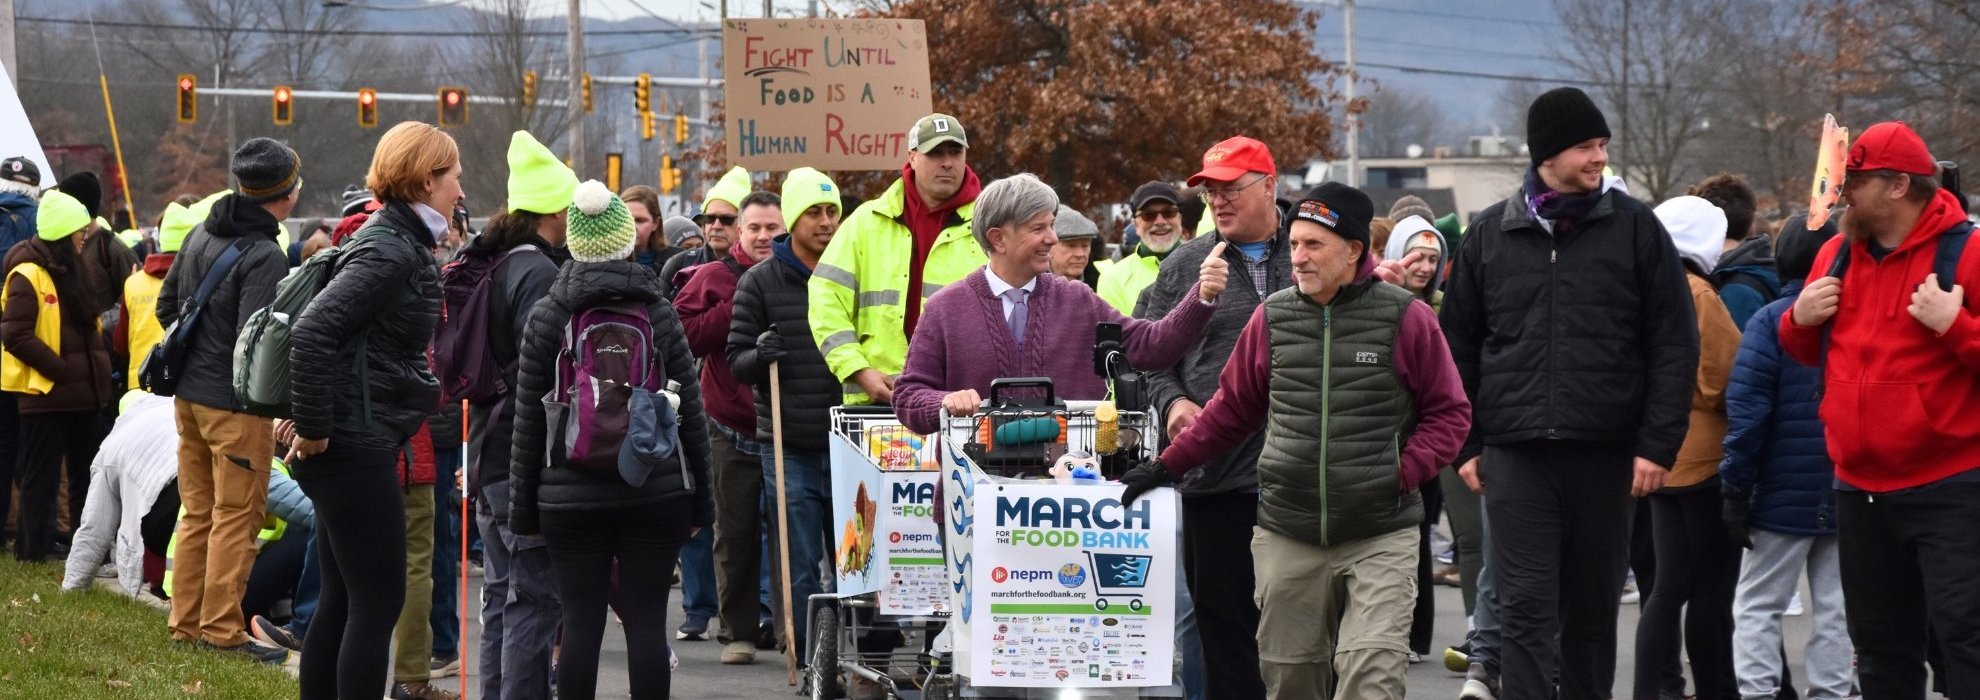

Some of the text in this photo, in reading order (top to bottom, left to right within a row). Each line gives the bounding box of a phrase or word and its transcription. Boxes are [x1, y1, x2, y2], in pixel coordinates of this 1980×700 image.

[744, 36, 896, 68] FIGHT UNTIL
[760, 78, 875, 105] FOOD IS A
[738, 113, 906, 158] HUMAN RIGHT
[933, 118, 949, 133] D
[995, 496, 1150, 530] MARCH
[902, 534, 932, 545] nepm
[1011, 529, 1150, 549] FOOD BANK
[1010, 568, 1053, 582] nepm
[991, 591, 1086, 599] marchforthefoodbank.org
